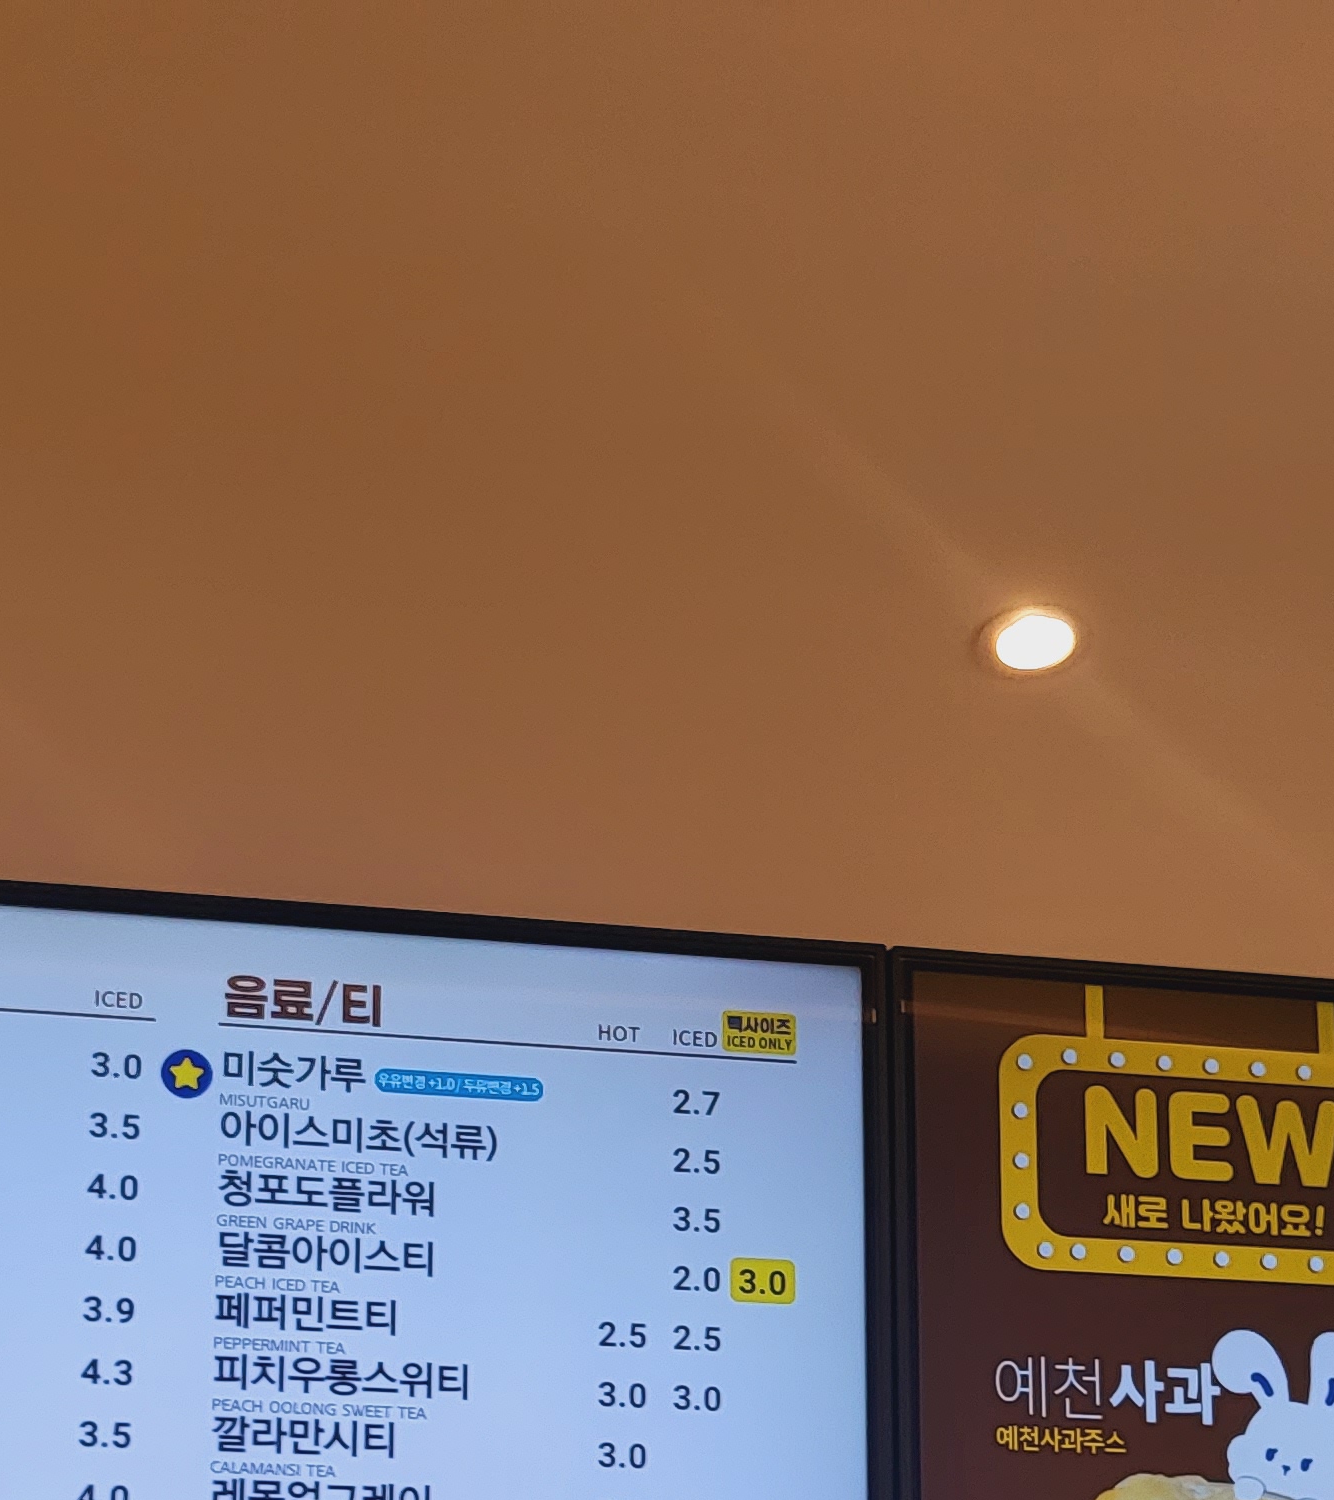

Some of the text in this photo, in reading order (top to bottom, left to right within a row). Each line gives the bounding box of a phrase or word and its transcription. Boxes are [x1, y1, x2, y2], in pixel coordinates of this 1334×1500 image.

[95, 990, 142, 1010] ICED
[225, 975, 382, 1027] 음료/티
[598, 1025, 717, 1048] HOT ICED
[727, 1033, 792, 1052] ICED ONLY
[91, 1053, 141, 1080] 3.0
[223, 1051, 365, 1093] 미숫가루
[219, 1095, 310, 1110] MISUTGARU
[672, 1090, 719, 1116] 2.7
[89, 1113, 140, 1139] 3.5
[220, 1110, 498, 1162] 아이스미초(석류)
[218, 1154, 408, 1176] POMEGRANATE ICED TEA
[672, 1149, 721, 1175] 2.5
[87, 1174, 138, 1200] 4.0
[217, 1170, 436, 1217] 청포도플라워
[217, 1215, 376, 1235] GREEN GRAPE DRINK
[672, 1208, 721, 1233] 3.5
[1103, 1194, 1325, 1236] 새로 나왔어요!
[217, 1231, 435, 1277] 달콤아이스티
[215, 1276, 340, 1293] PEACH ICED TEA
[672, 1267, 786, 1295] 2.0 3.0
[83, 1297, 135, 1322] 3.9
[215, 1293, 398, 1335] 페퍼민트티
[213, 1337, 345, 1355] PEPPERMINT TEA
[598, 1323, 721, 1352] 2.5 2.5
[81, 1359, 133, 1386] 4.3
[214, 1354, 469, 1399] 피치우롱스위티
[995, 1356, 1221, 1425] 예천사과
[78, 1421, 131, 1448] 3.5
[211, 1418, 395, 1459] 깔라만시티
[996, 1425, 1127, 1453] 예천사과주스
